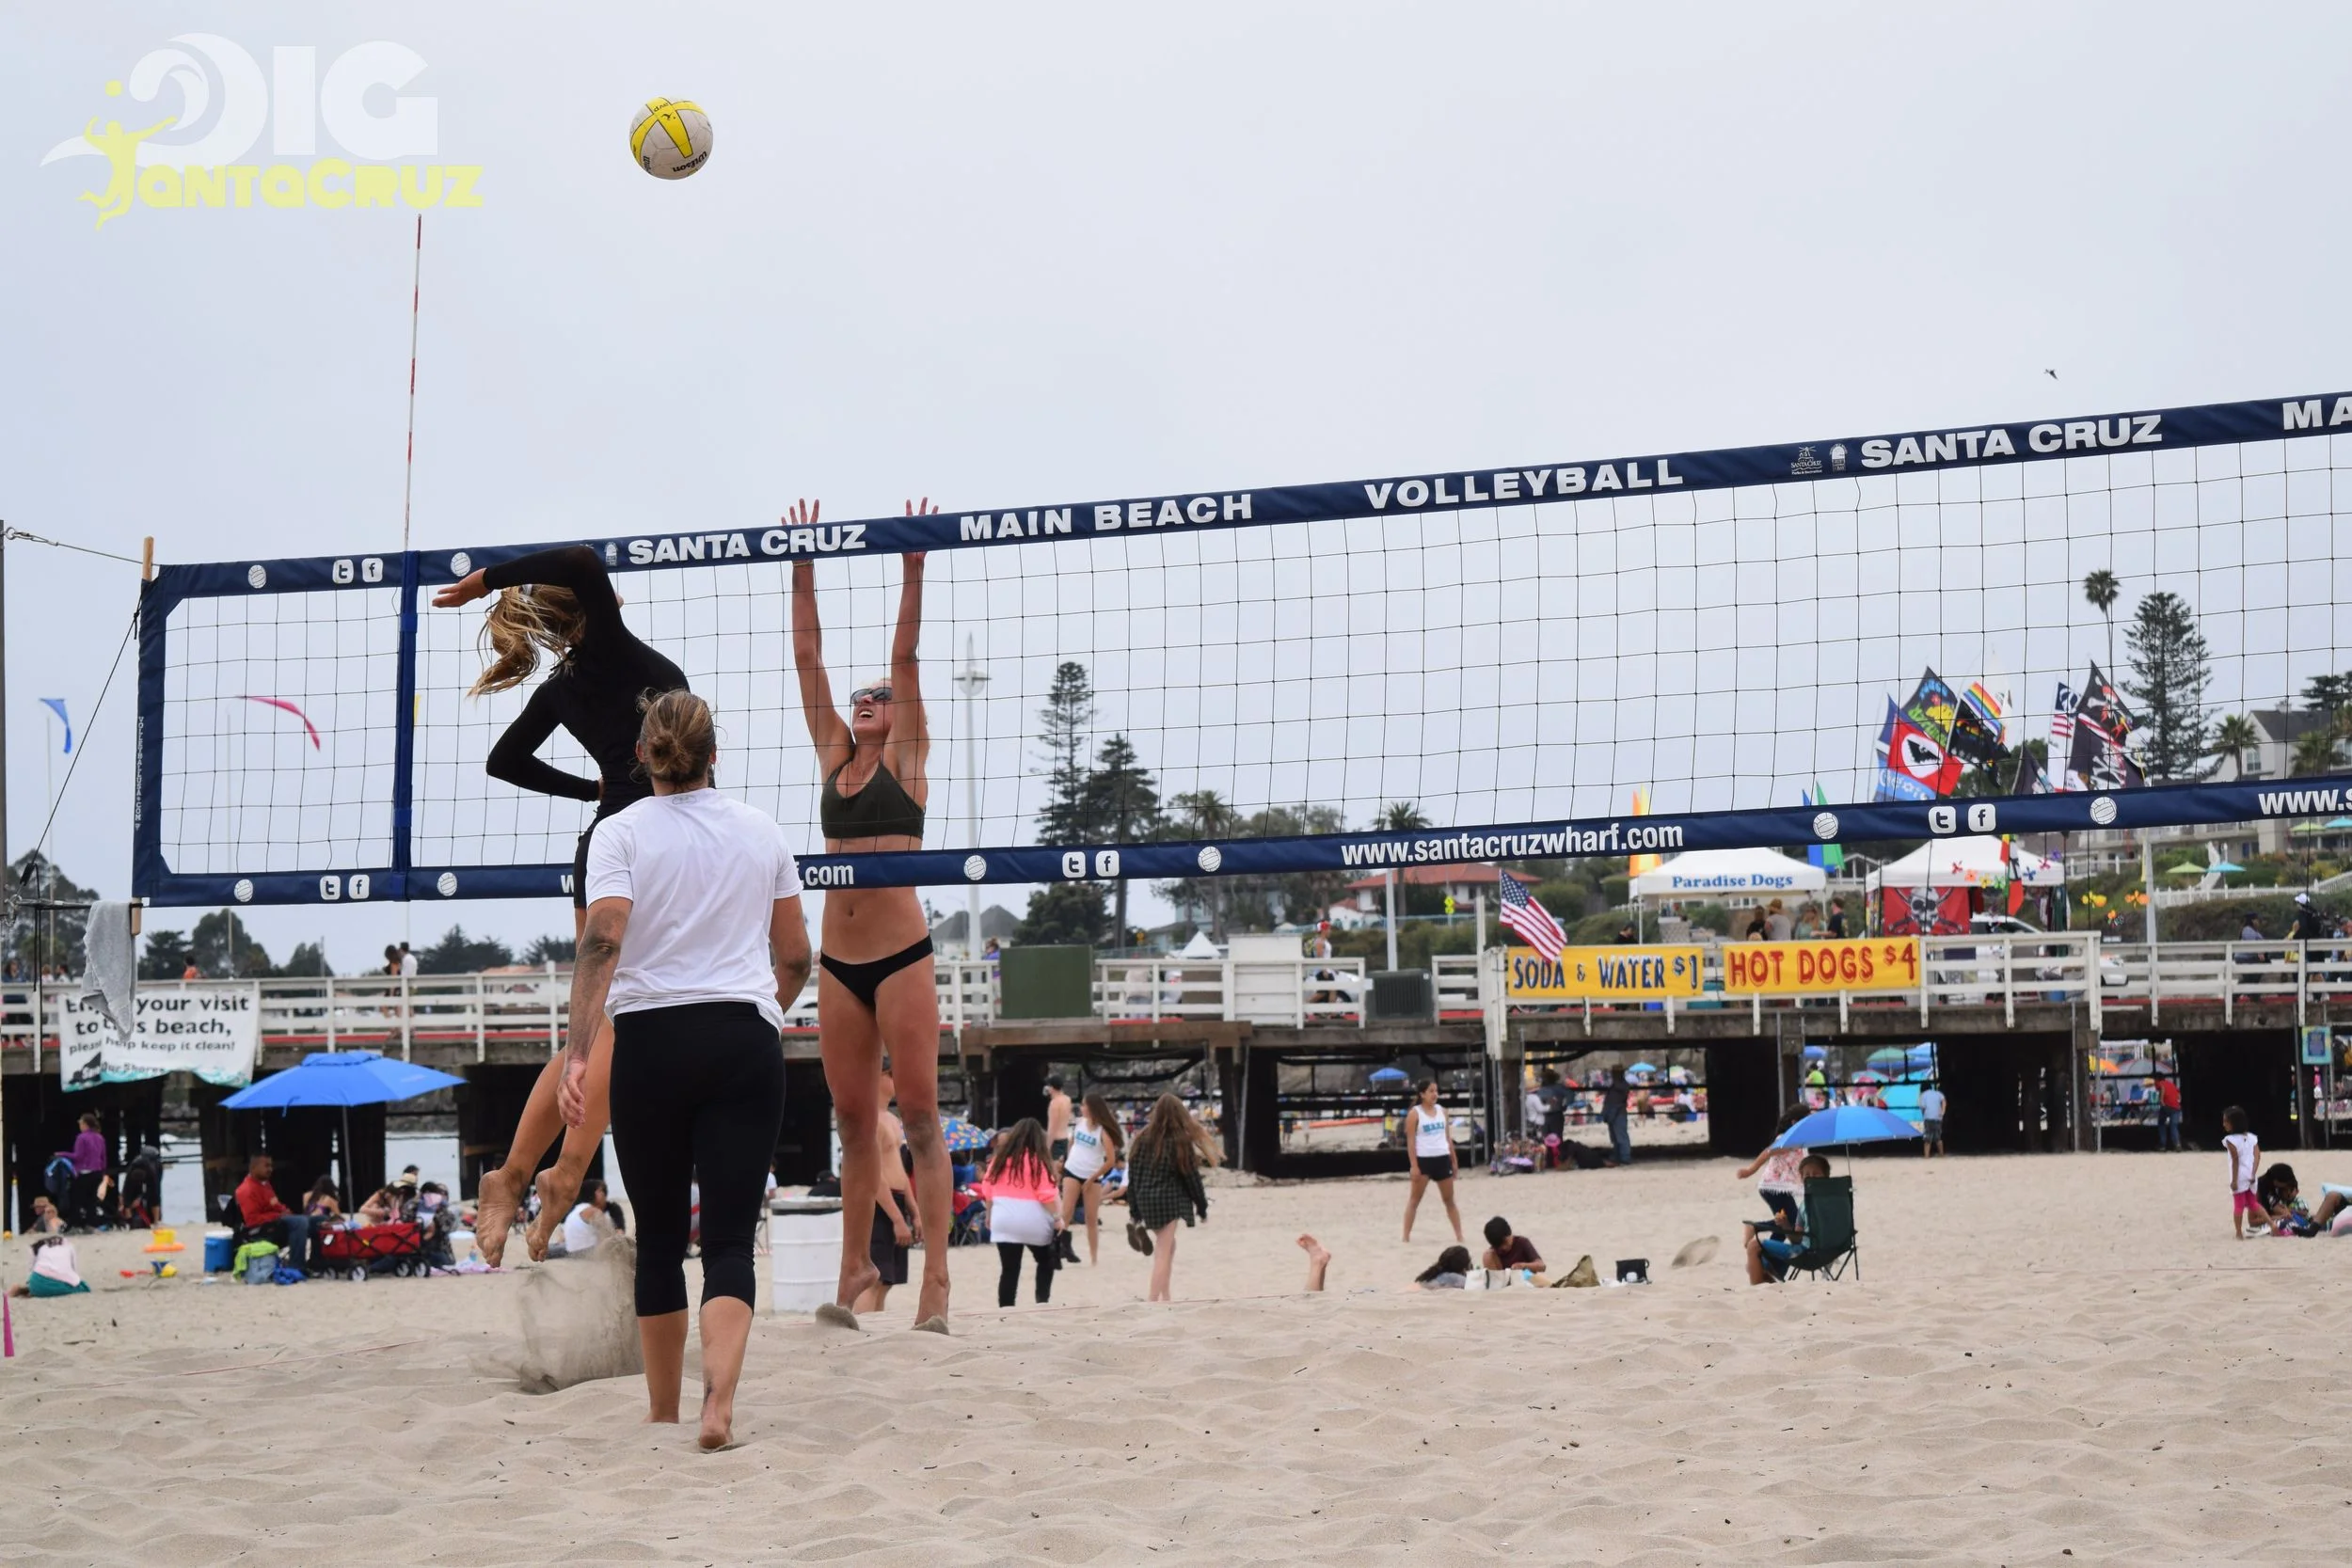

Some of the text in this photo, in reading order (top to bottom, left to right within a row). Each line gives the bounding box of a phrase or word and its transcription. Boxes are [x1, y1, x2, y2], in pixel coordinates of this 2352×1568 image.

[673, 151, 707, 172] Wilson
[1861, 429, 2016, 468] SANTA
[2028, 415, 2162, 452] CRUZ
[1364, 459, 1683, 509] VOLLEYBALL
[961, 494, 1252, 541] MAIN BEACH
[628, 532, 751, 564] SANTA
[760, 524, 866, 555] CRUZ
[1342, 823, 1684, 865] www.santacruzwharf.com
[1672, 874, 1793, 888] Paradise Dogs
[1514, 955, 1565, 989] SODA
[1577, 964, 1585, 982] &
[1597, 955, 1665, 989] WATER
[1728, 942, 1916, 987] HOT DOGS $4
[136, 994, 248, 1015] your visit
[76, 1021, 99, 1036] to
[155, 1018, 231, 1037] beach,
[141, 1040, 176, 1052] keep
[181, 1040, 191, 1052] it
[195, 1040, 235, 1052] clean!
